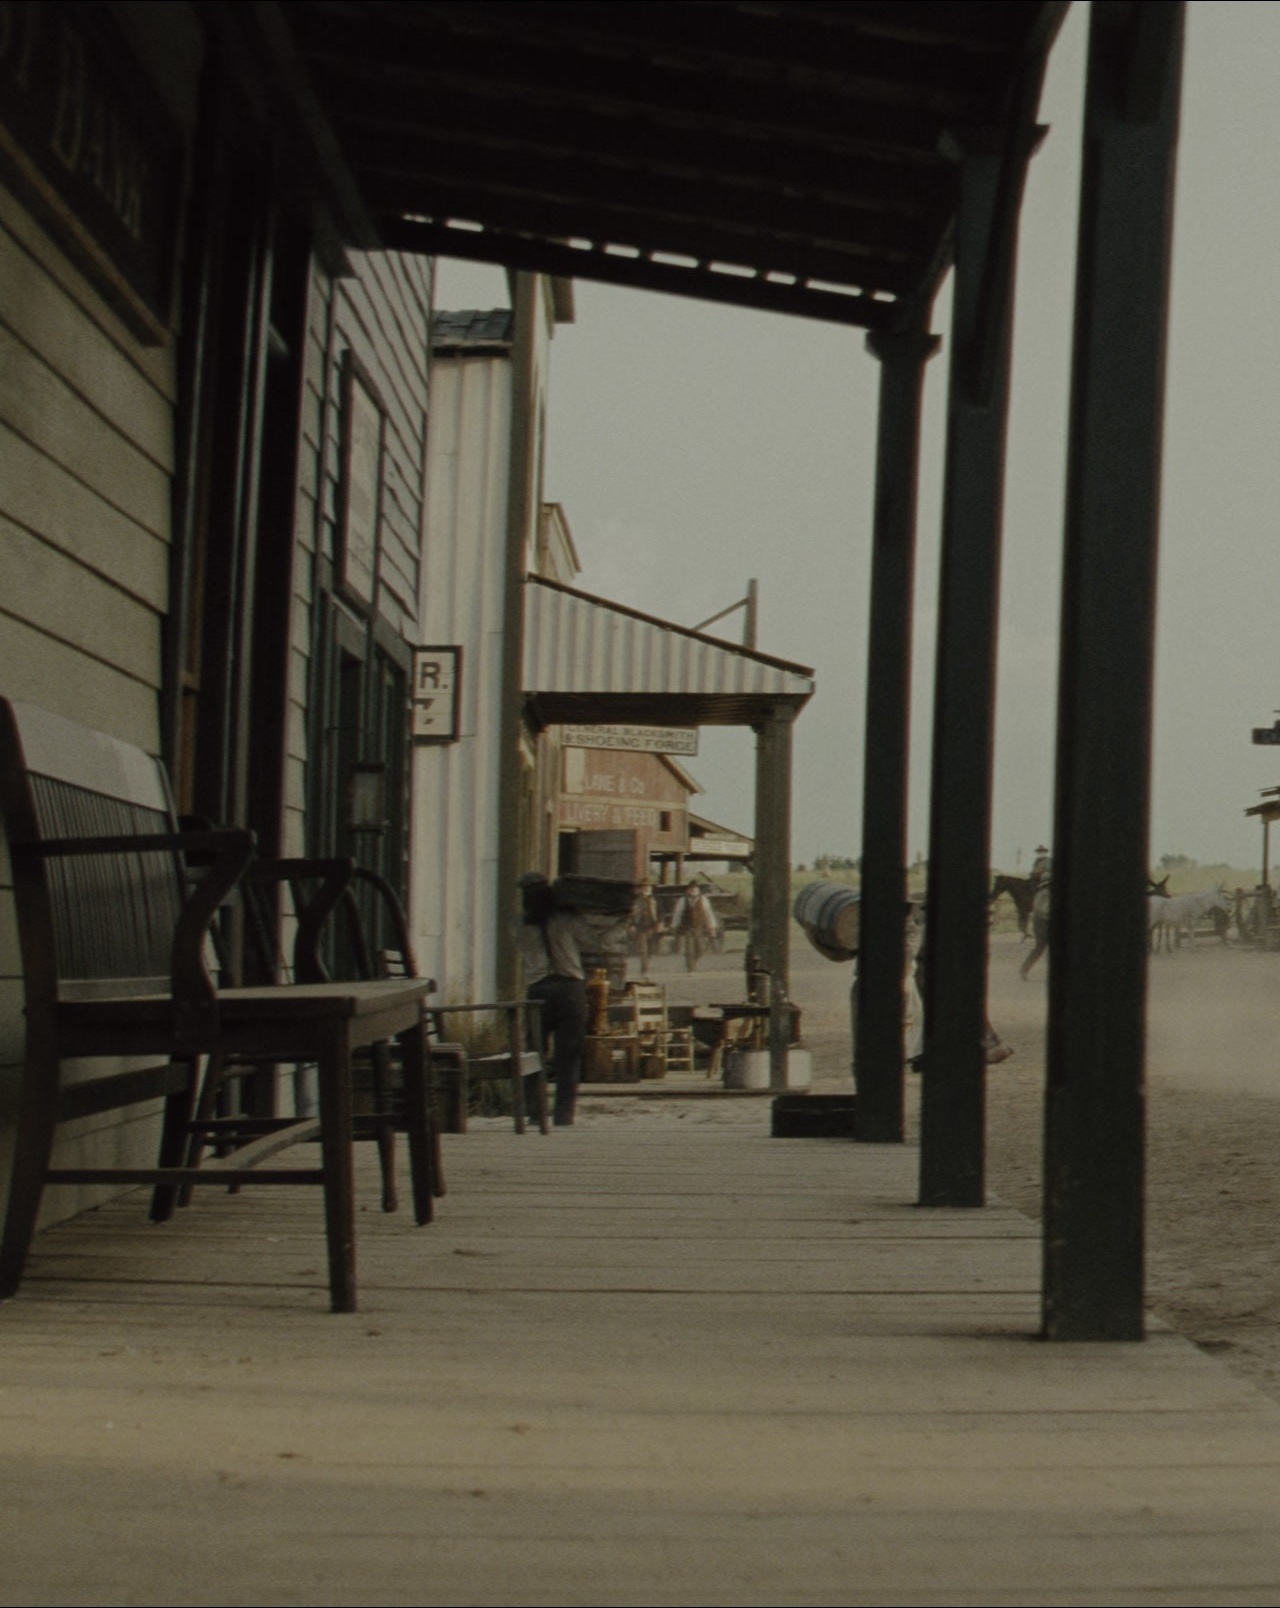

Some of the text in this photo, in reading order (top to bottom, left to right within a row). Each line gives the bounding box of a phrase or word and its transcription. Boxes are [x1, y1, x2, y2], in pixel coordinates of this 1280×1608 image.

[567, 725, 694, 739] GENERAL BLACKSMITH
[576, 734, 640, 748] SHOEING
[645, 738, 695, 752] FORGE
[627, 806, 657, 826] FEED
